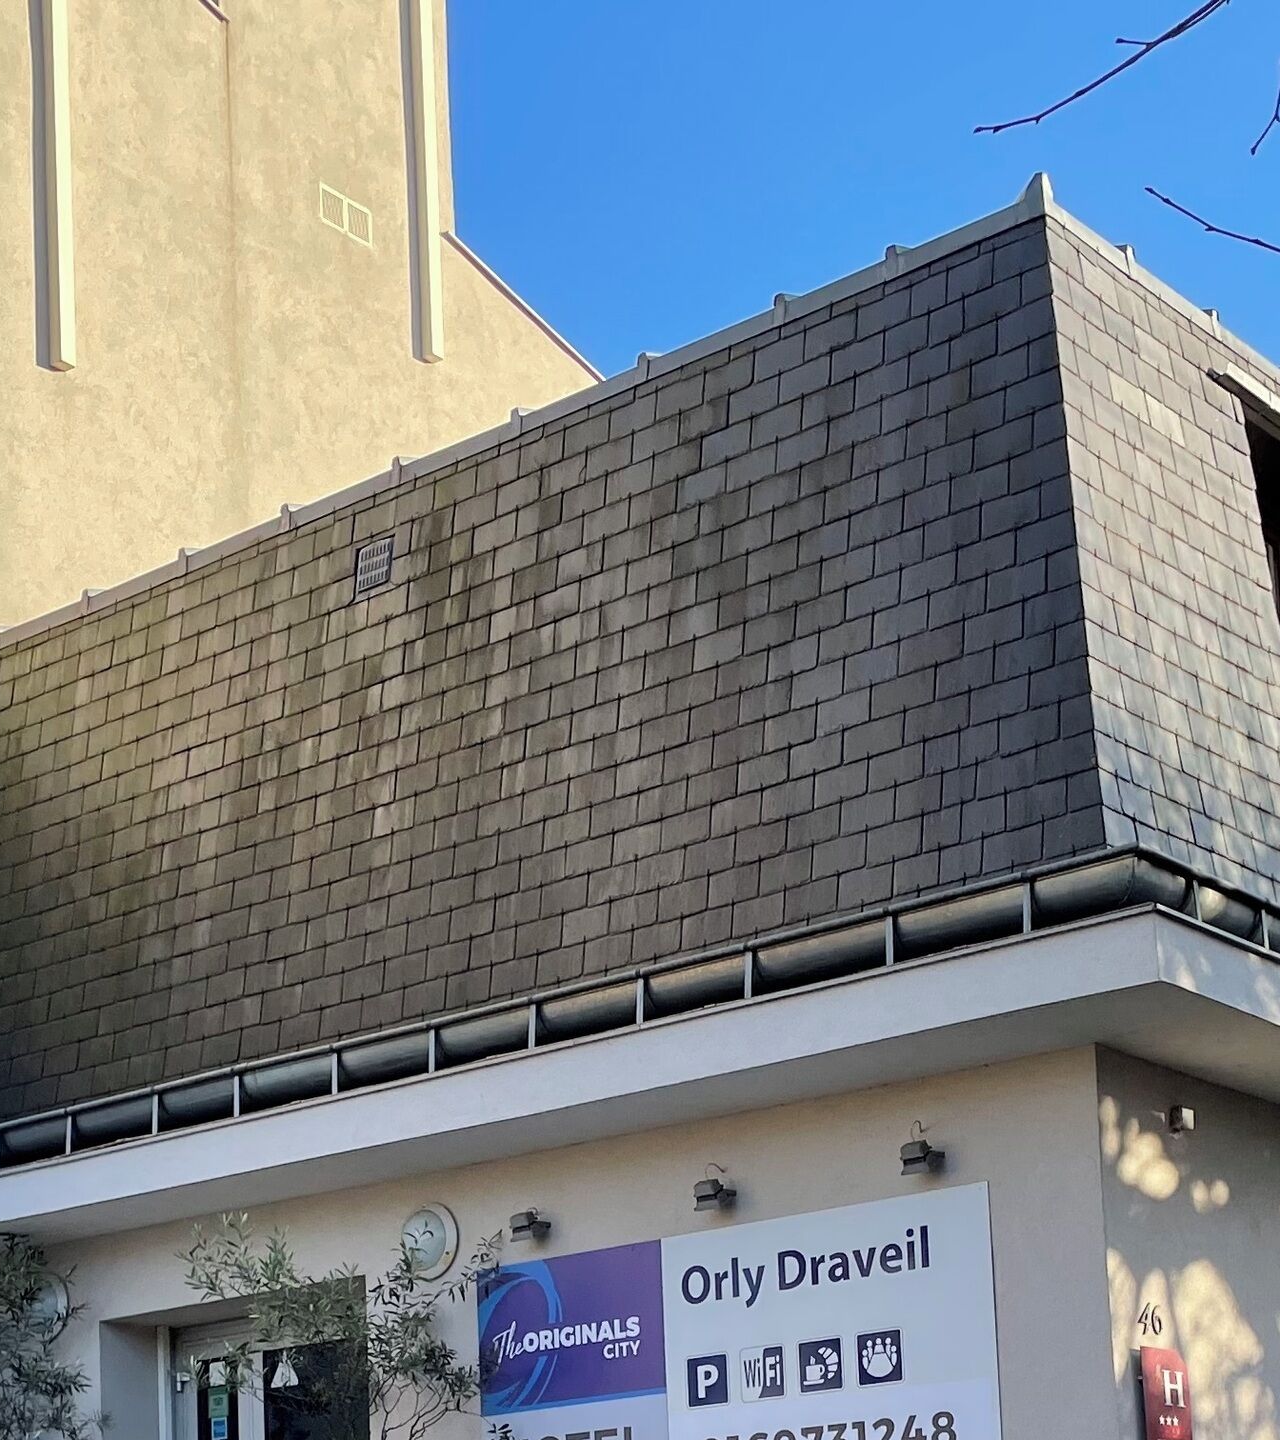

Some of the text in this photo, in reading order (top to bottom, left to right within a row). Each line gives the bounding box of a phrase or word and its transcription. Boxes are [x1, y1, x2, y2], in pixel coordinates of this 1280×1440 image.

[680, 1224, 931, 1309] Orly Draveil
[1137, 1302, 1163, 1336] 46
[492, 1315, 641, 1372] The ORIGINALS
[602, 1339, 641, 1360] CITY
[696, 1364, 719, 1399] P
[1161, 1369, 1186, 1408] H
